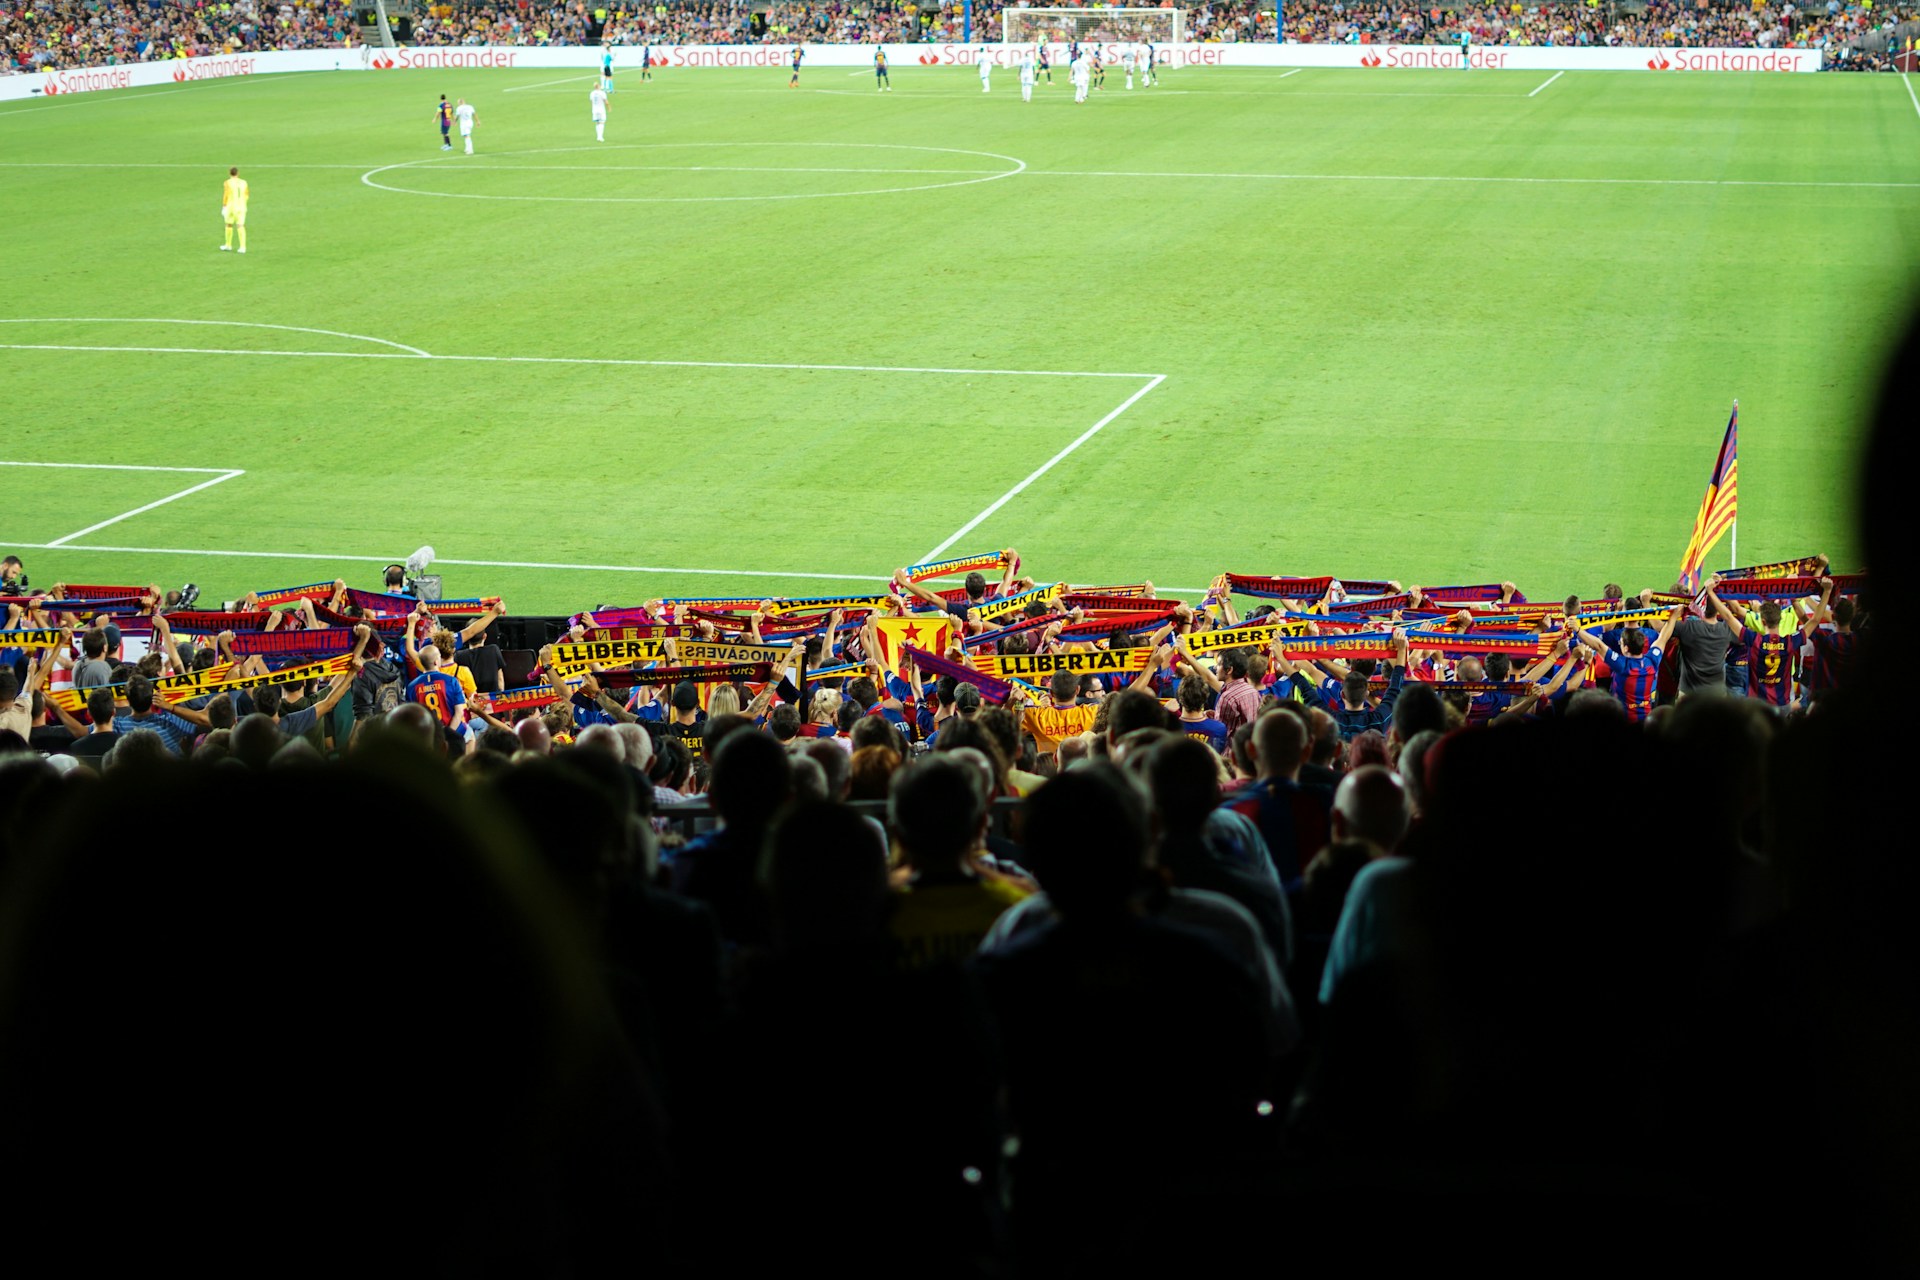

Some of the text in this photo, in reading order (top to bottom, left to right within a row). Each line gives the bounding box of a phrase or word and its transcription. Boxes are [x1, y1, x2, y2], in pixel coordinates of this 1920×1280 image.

[399, 49, 517, 68] Santander
[673, 47, 790, 66] Santander
[944, 45, 1060, 64] Santandr
[1107, 45, 1224, 64] Sander
[1387, 47, 1507, 68] Santander
[1675, 50, 1802, 71] Santander
[187, 57, 256, 80] Santander
[59, 70, 131, 94] Santander
[1189, 625, 1303, 650] LLIBERTAT
[558, 641, 666, 663] LLIBERTA
[1001, 651, 1128, 675] LLIBERTAT
[1765, 653, 1782, 675] 9
[425, 693, 442, 720] 8
[1046, 724, 1084, 736] BARÇA
